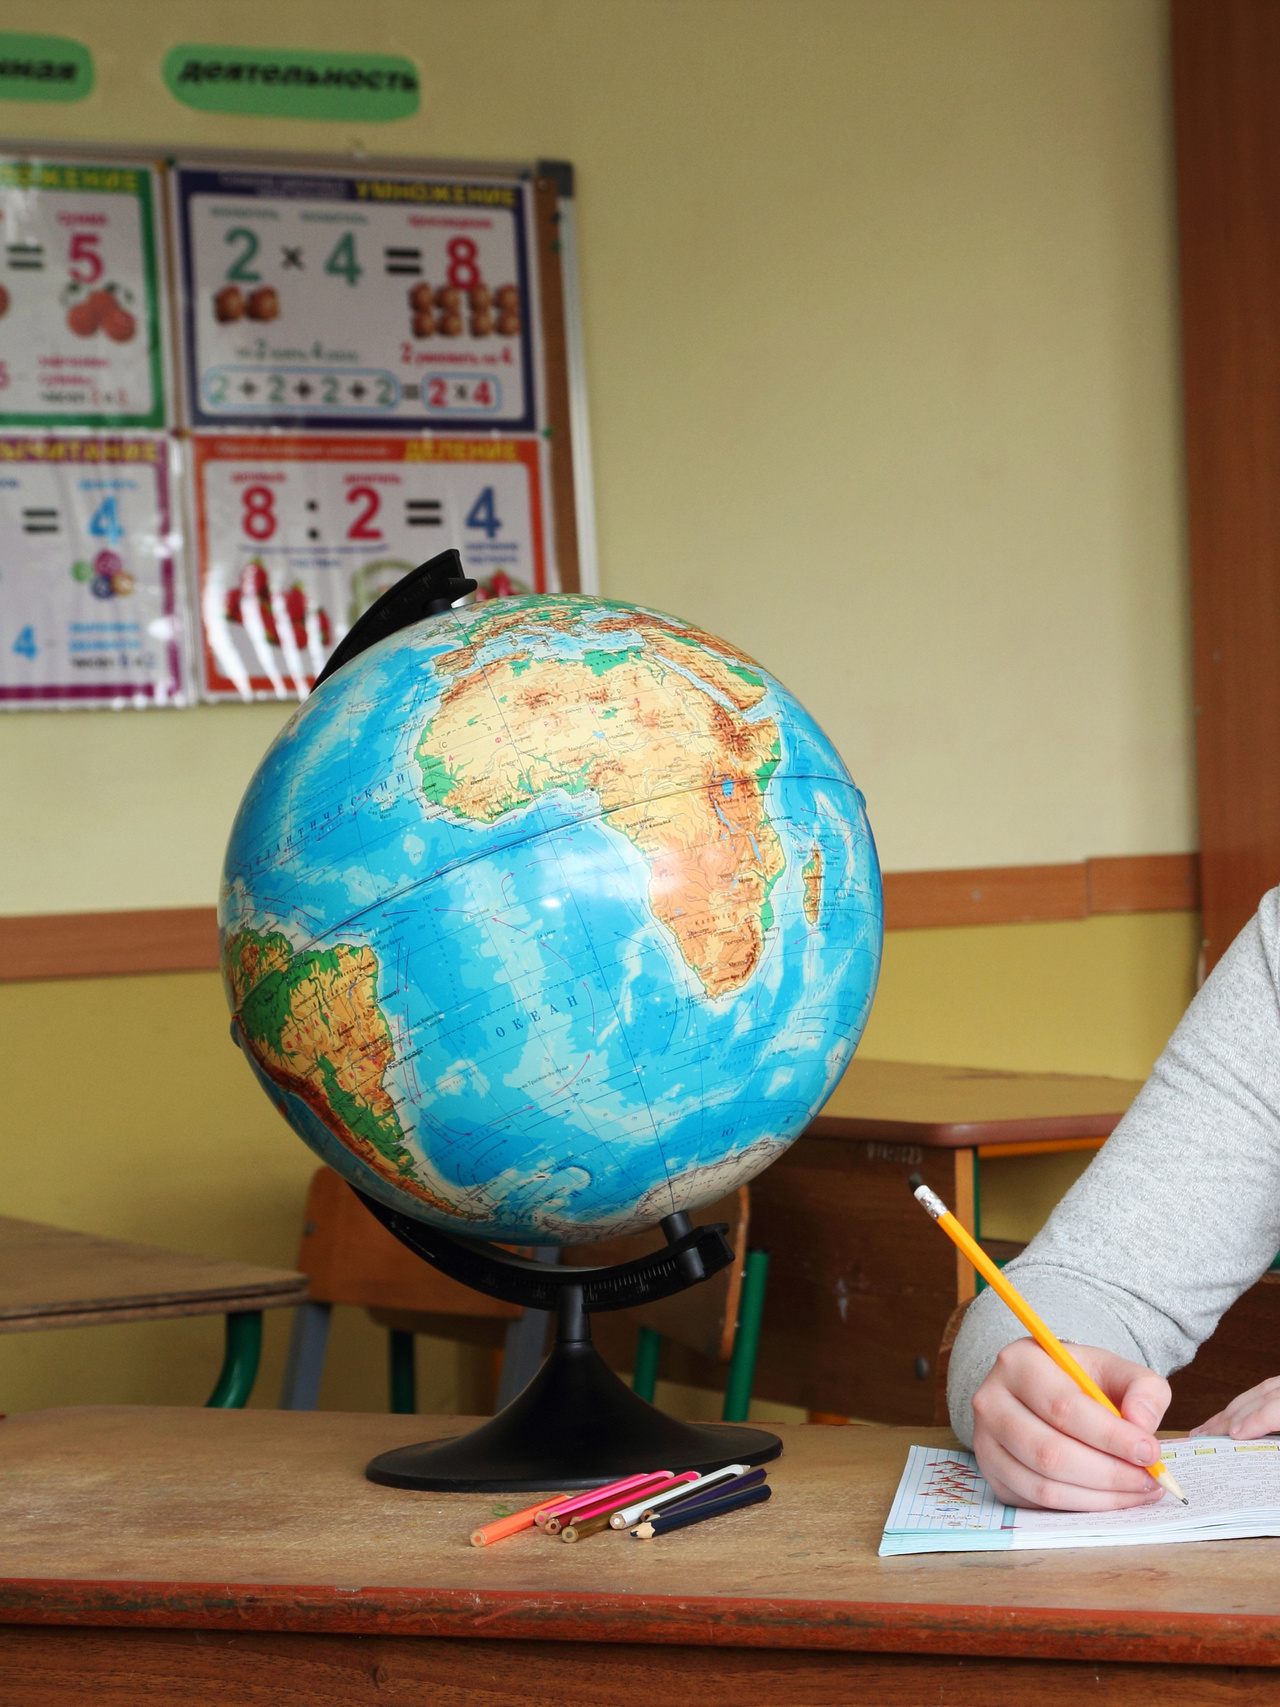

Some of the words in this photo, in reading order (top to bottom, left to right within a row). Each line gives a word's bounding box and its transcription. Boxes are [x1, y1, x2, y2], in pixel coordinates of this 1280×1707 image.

[178, 59, 419, 93] деятельность
[69, 233, 104, 285] 5
[225, 226, 262, 282] 2
[325, 231, 363, 286] 4
[446, 236, 481, 292] 8
[428, 377, 447, 407] 2
[474, 378, 492, 405] 4
[88, 496, 124, 546] 4
[241, 485, 278, 542] 8
[345, 485, 383, 541] 2
[465, 485, 502, 539] 4
[12, 624, 38, 662] 4
[494, 994, 578, 1038] ОКЕАН
